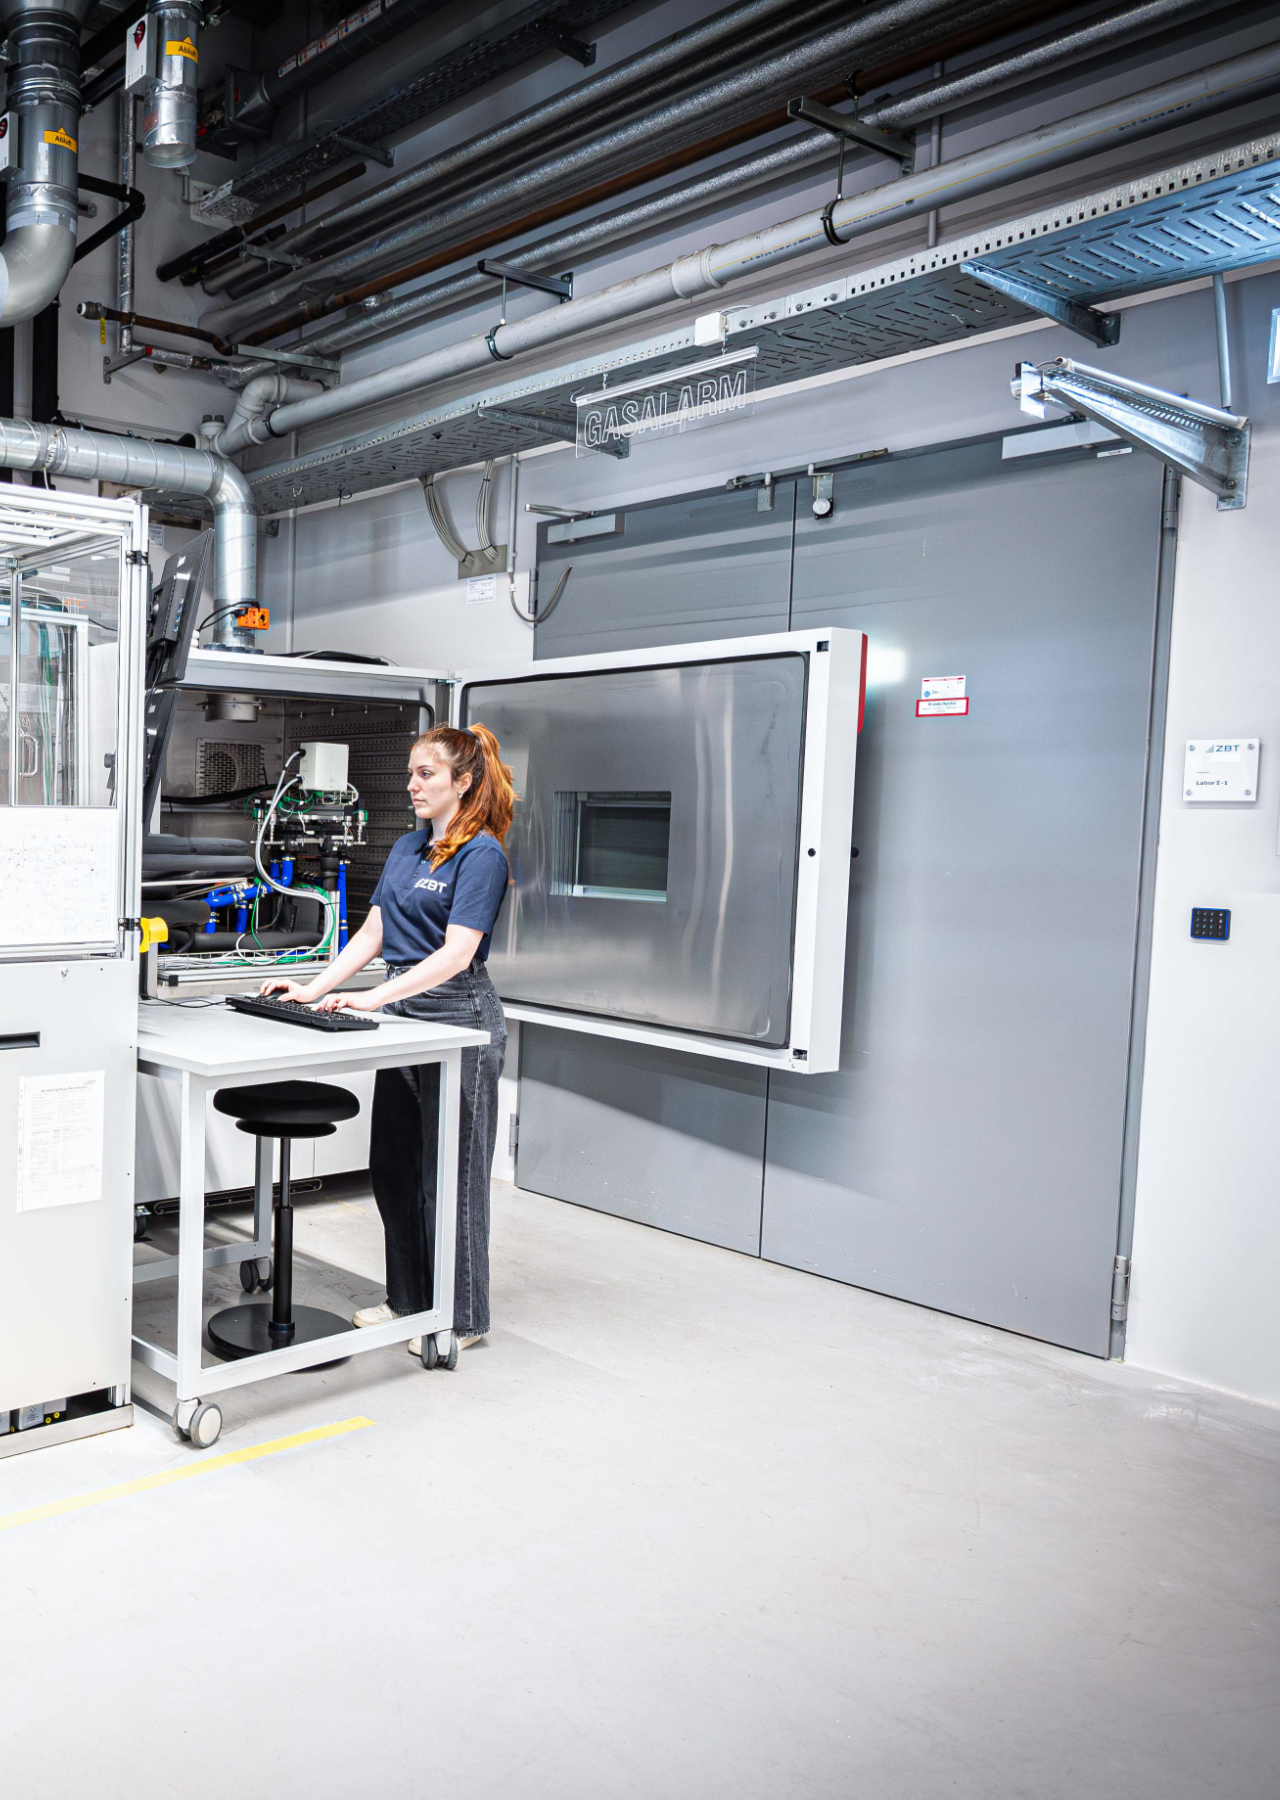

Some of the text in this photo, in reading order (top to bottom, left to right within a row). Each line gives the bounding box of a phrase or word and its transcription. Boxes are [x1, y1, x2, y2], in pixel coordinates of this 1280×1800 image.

[584, 370, 747, 447] GASALARM
[1215, 744, 1240, 753] ZBT
[419, 878, 447, 893] ZBT
